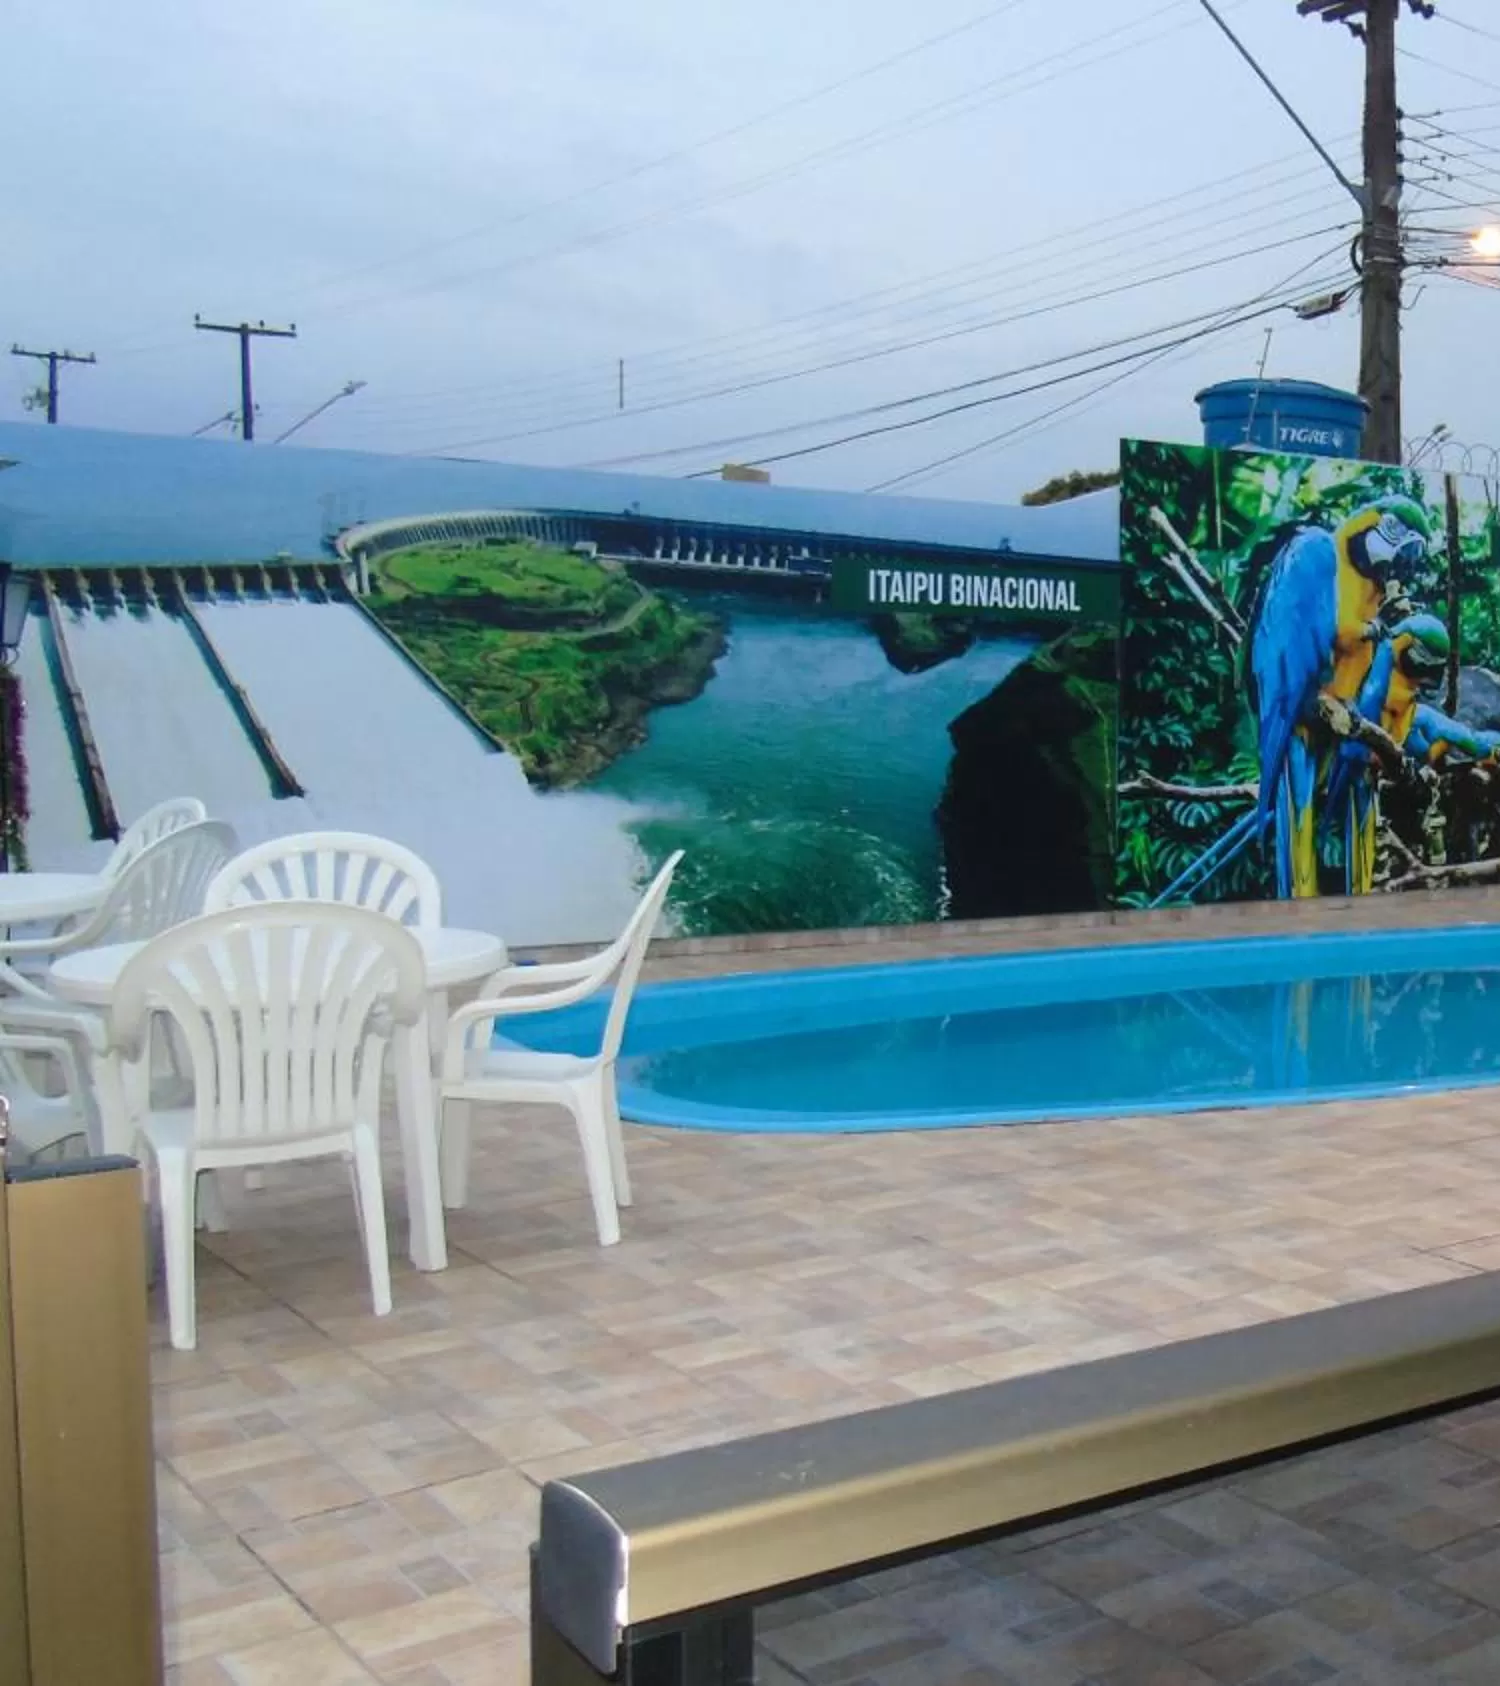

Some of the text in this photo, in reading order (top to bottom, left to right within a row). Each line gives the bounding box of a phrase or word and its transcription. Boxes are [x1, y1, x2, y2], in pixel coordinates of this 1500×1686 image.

[1279, 427, 1329, 445] TIGRE
[868, 568, 1081, 612] ITAIPU BINACIONAL
